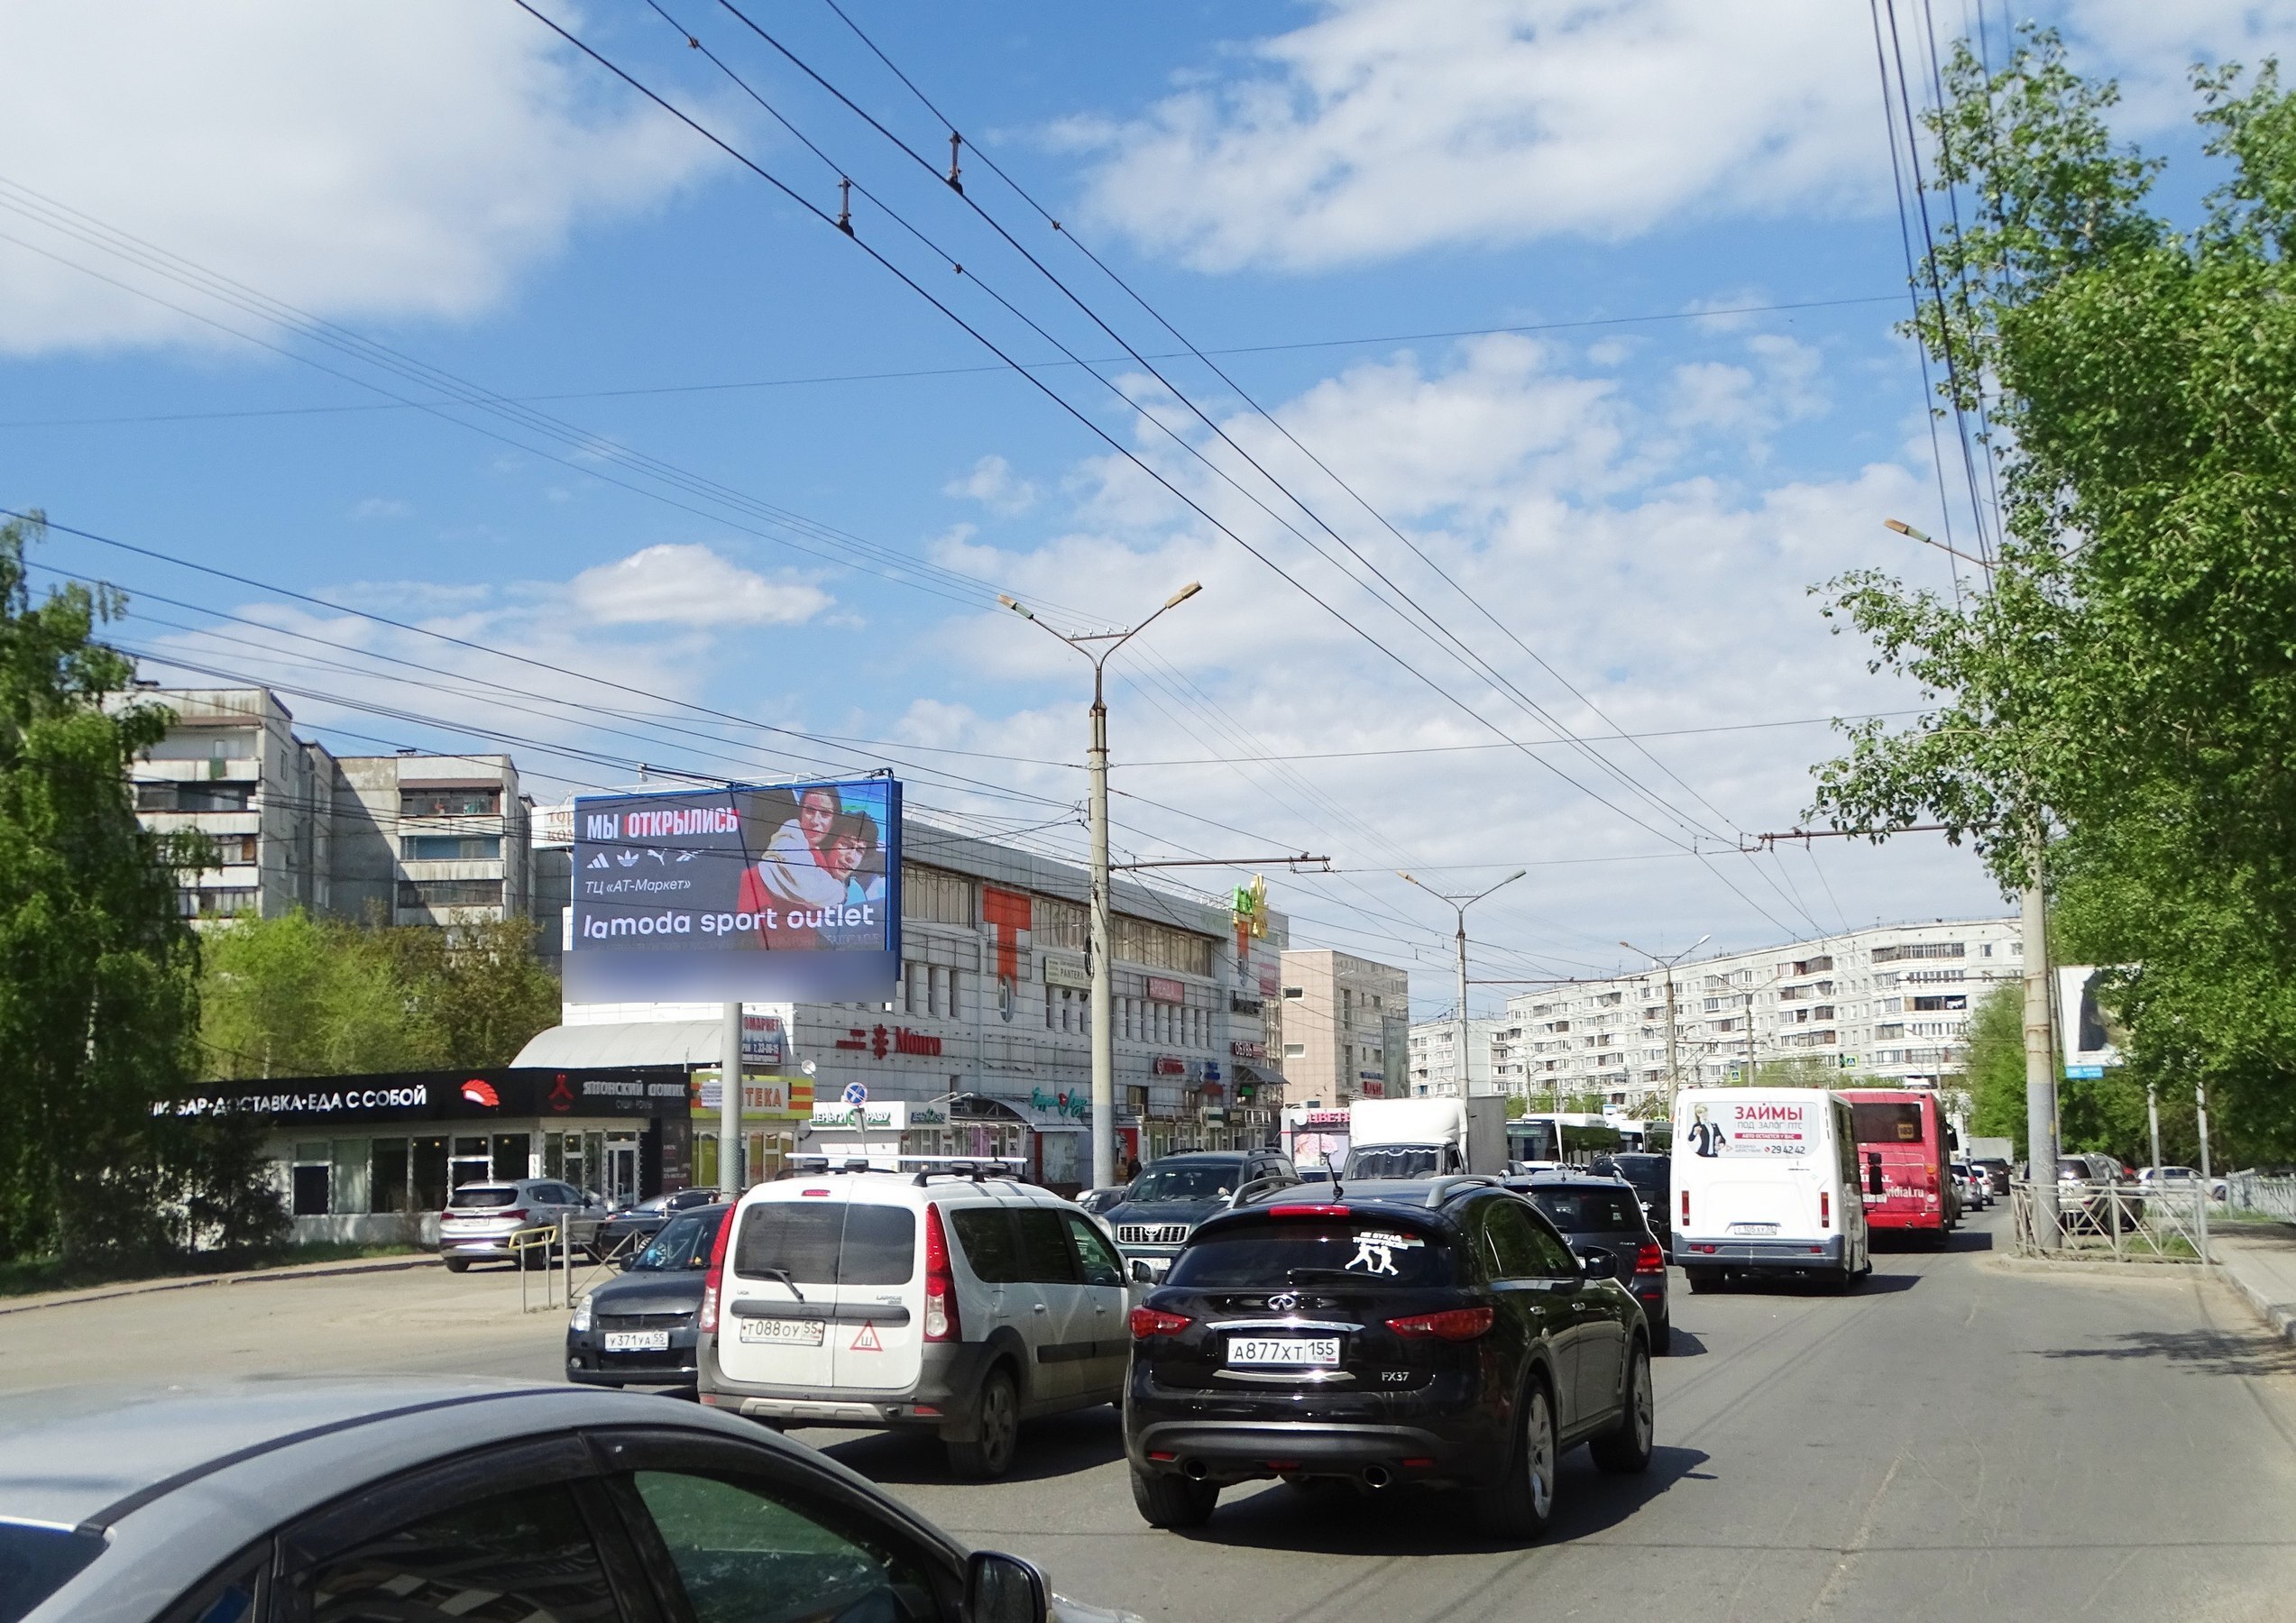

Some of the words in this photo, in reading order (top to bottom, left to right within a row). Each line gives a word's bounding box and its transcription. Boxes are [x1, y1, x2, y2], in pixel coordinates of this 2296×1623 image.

[587, 813, 619, 840] МЫ
[628, 808, 738, 839] ОТКРЫЛИСЬ
[586, 881, 603, 895] ТЦ
[606, 878, 691, 894] «АТ-Маркет»
[583, 911, 691, 940] lamoda
[700, 908, 778, 936] sport
[786, 903, 874, 930] outlet
[743, 1016, 780, 1032] ОМАРКЕТ
[583, 1080, 644, 1096] ЯПОНСКИЙ
[308, 1092, 343, 1113] ЕДА
[345, 1091, 361, 1108] С
[362, 1084, 427, 1108] СОБОЙ
[745, 1087, 782, 1107] ТЕКА
[1734, 1103, 1803, 1121] ЗАЙМЫ
[1738, 1122, 1755, 1130] ПОД
[1759, 1122, 1785, 1130] ЗАЛОГ
[1788, 1122, 1803, 1130] ПТС
[1771, 1145, 1782, 1153] 29
[1783, 1146, 1794, 1154] 42
[1795, 1146, 1805, 1154] 42
[1885, 1186, 1924, 1198] vidial.ru
[860, 1336, 873, 1347] Ш
[1234, 1342, 1303, 1361] А877ХТ
[1308, 1342, 1335, 1356] 155
[1381, 1371, 1410, 1381] FX37
